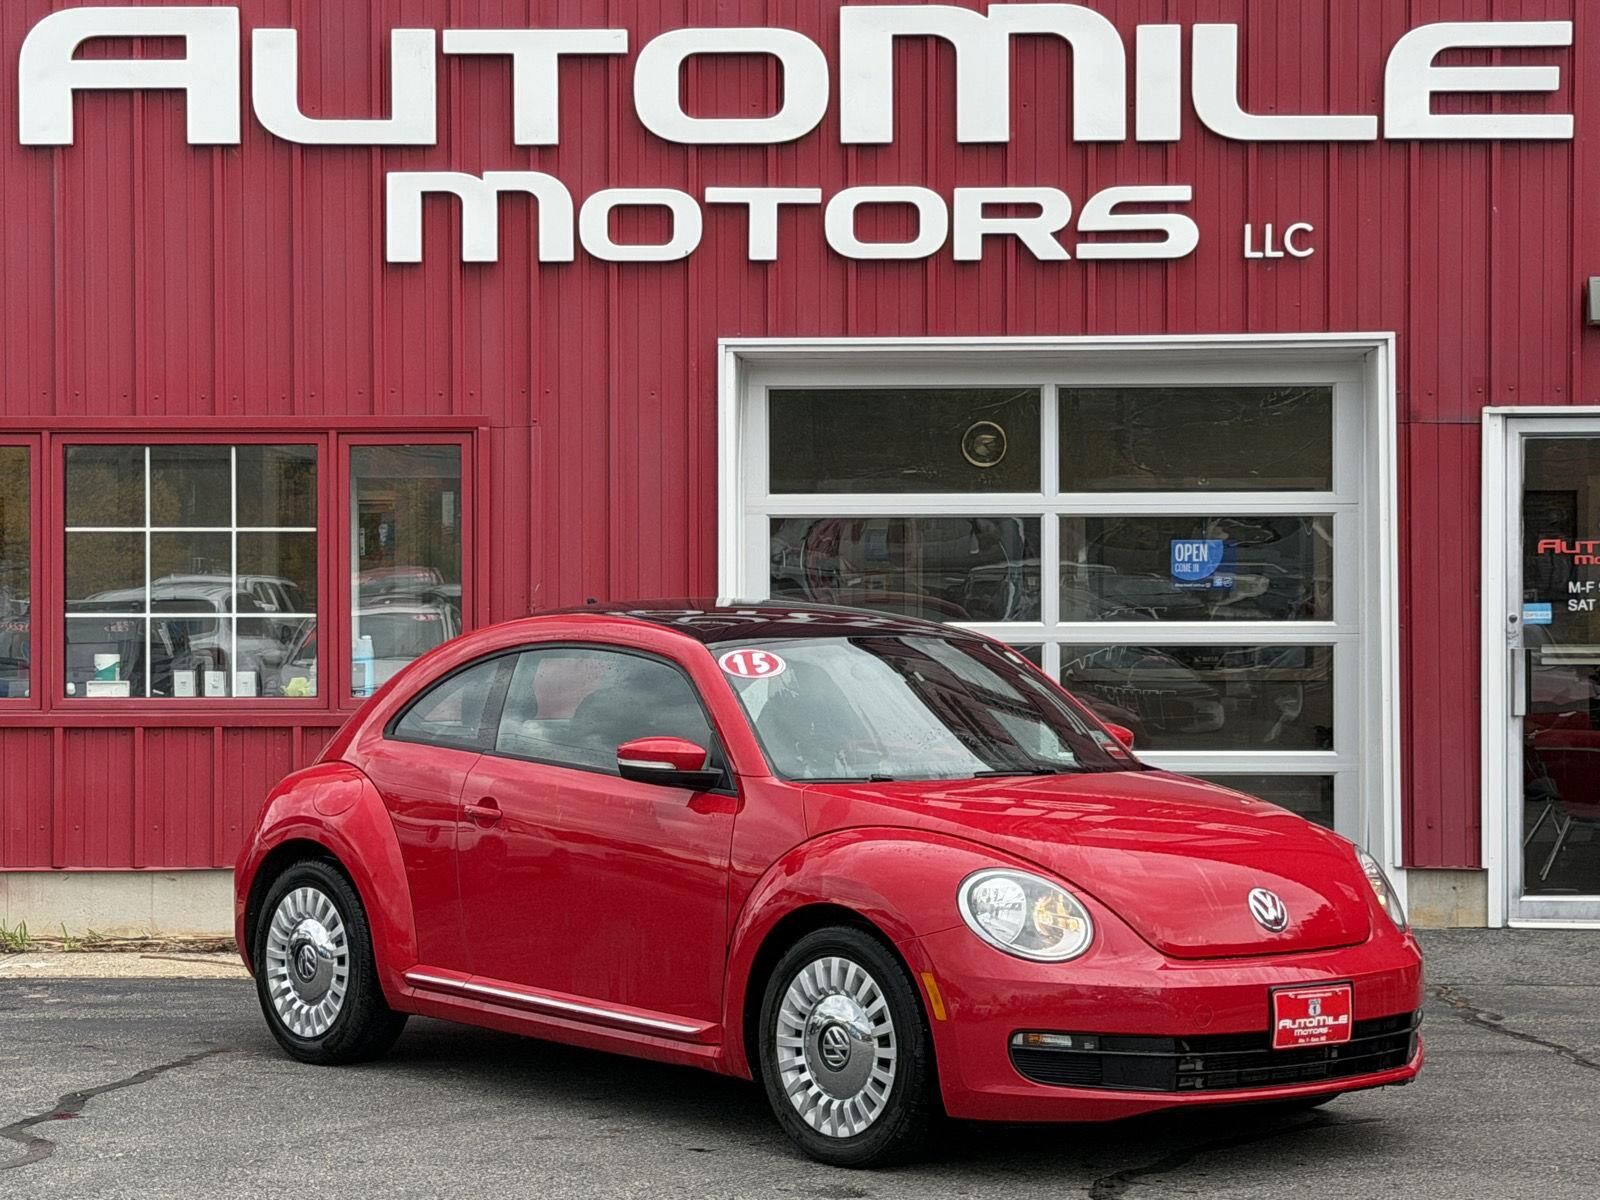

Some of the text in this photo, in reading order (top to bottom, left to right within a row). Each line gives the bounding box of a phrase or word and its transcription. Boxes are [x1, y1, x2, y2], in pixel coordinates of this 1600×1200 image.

[18, 3, 1574, 146] AUTOMILE
[386, 170, 1315, 263] MOTORS LLC
[1174, 543, 1208, 562] OPEN
[1568, 581, 1595, 594] M-F
[1567, 599, 1596, 611] SAT
[732, 652, 770, 675] 15
[1278, 1014, 1348, 1030] AUTOMILE
[1294, 1026, 1329, 1037] MOTORS
